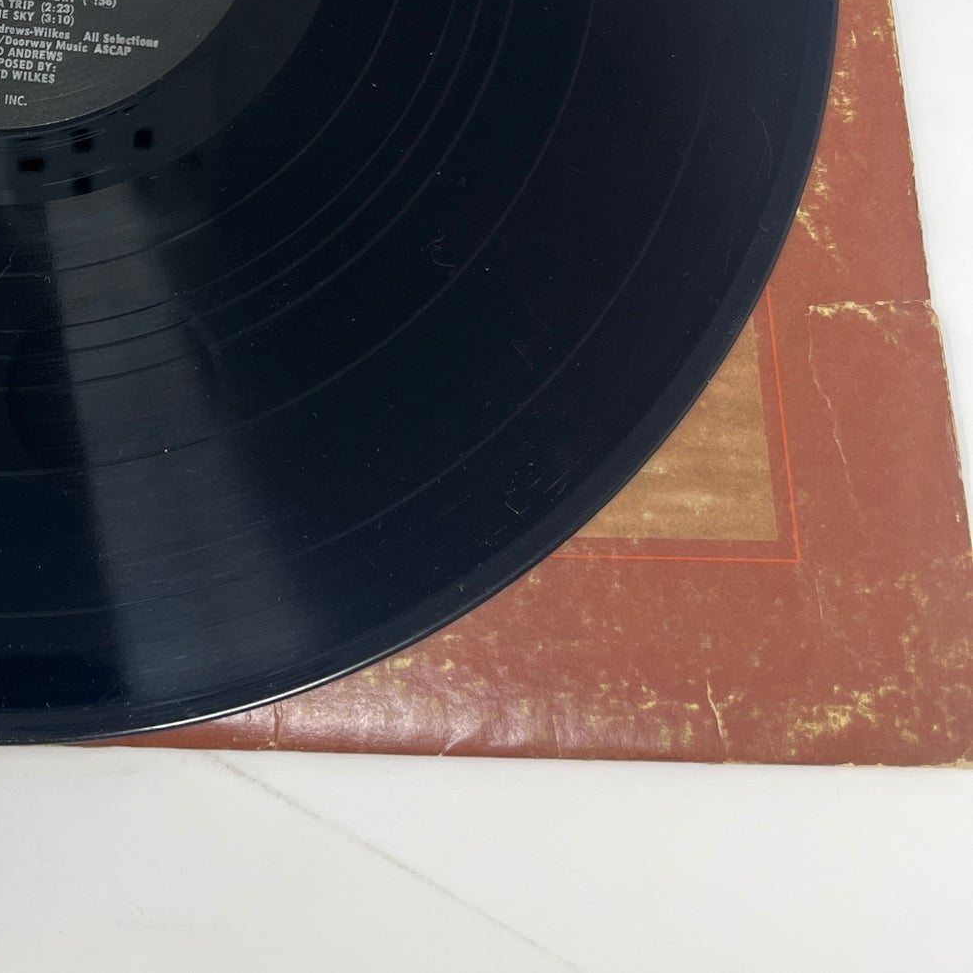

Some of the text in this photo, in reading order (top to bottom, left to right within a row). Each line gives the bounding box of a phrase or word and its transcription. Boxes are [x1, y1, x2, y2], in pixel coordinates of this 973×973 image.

[9, 0, 35, 9] TRIP
[41, 1, 75, 15] (2:23)
[13, 10, 35, 21] SKY
[41, 14, 75, 26] (3:10)
[83, 31, 99, 42] All
[103, 33, 159, 48] Selections
[8, 48, 63, 62] ANDREWS
[56, 41, 88, 52] Music
[94, 44, 131, 56] ASCAP
[38, 61, 56, 73] BY:
[12, 70, 55, 84] WILKES
[5, 95, 27, 106] INC.
